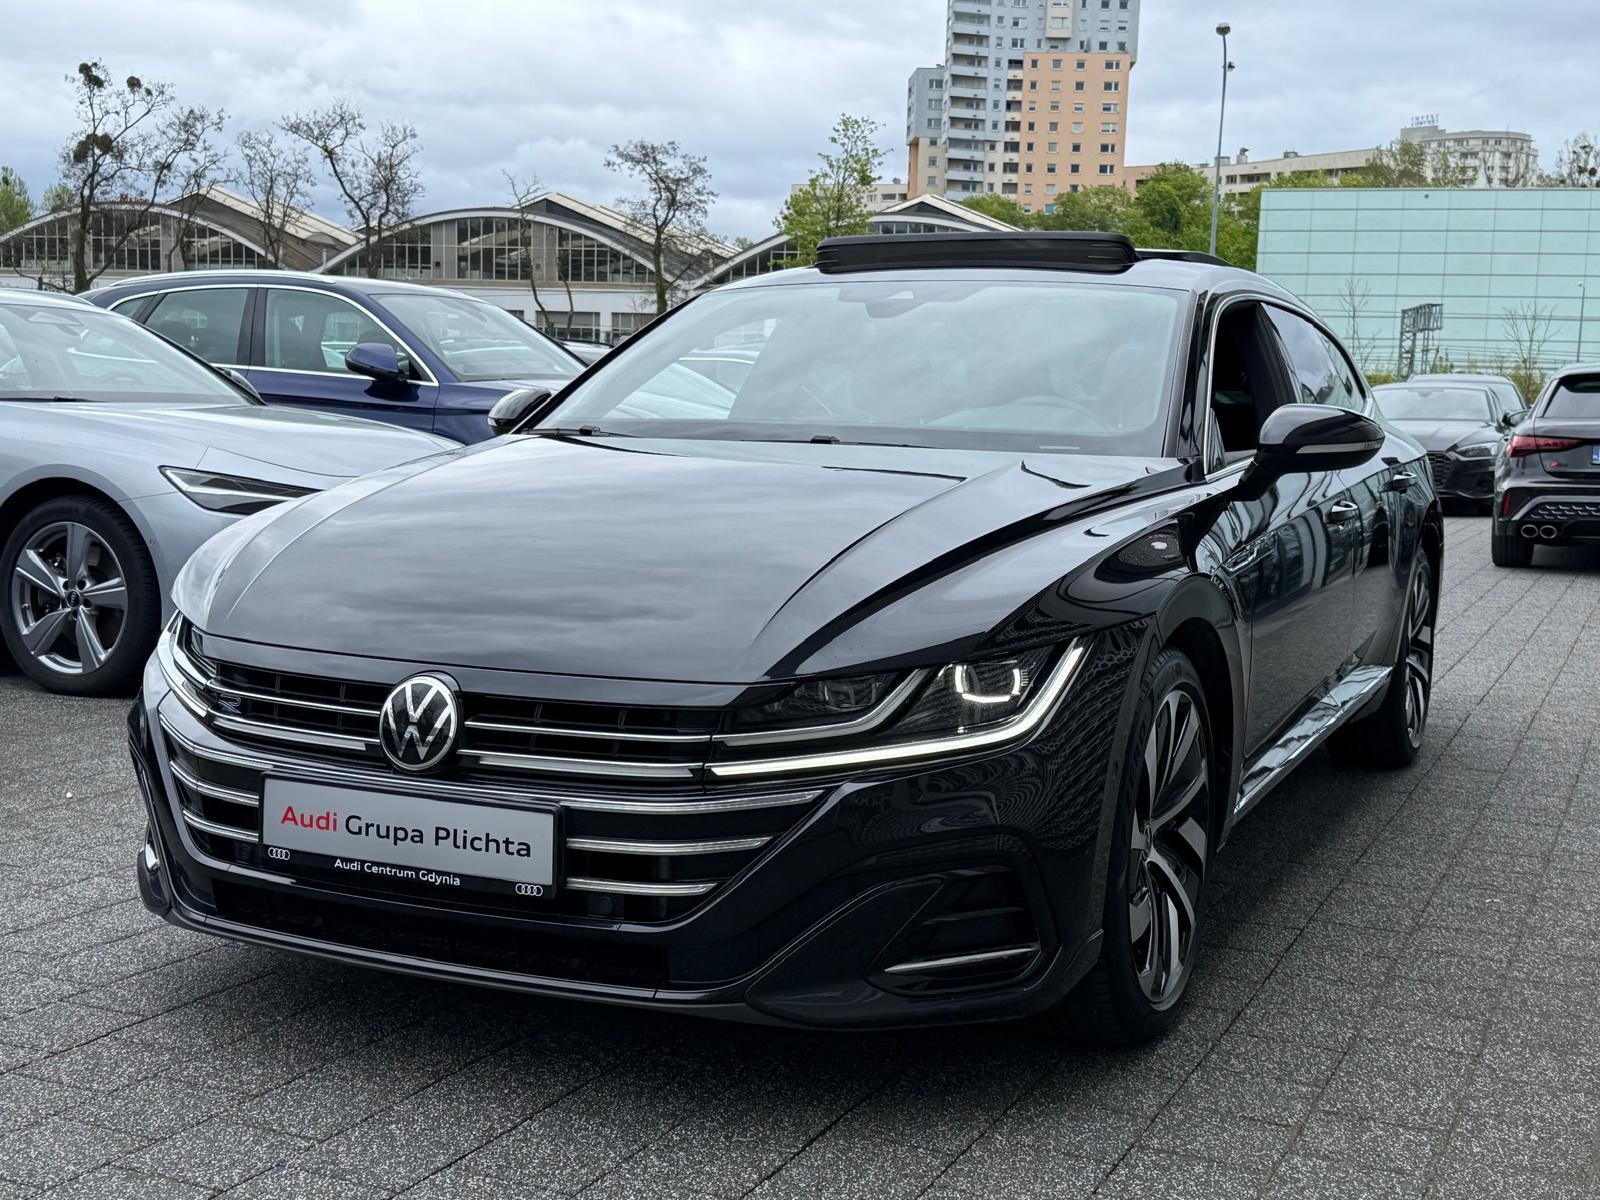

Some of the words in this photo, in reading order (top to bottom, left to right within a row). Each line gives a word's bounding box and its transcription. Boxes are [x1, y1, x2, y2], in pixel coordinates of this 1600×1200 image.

[280, 805, 338, 832] Audi
[345, 814, 425, 846] Grupa
[434, 826, 531, 858] Plichta
[334, 858, 361, 871] Audi
[364, 862, 416, 879] Centrum
[419, 870, 461, 886] Gdynia
